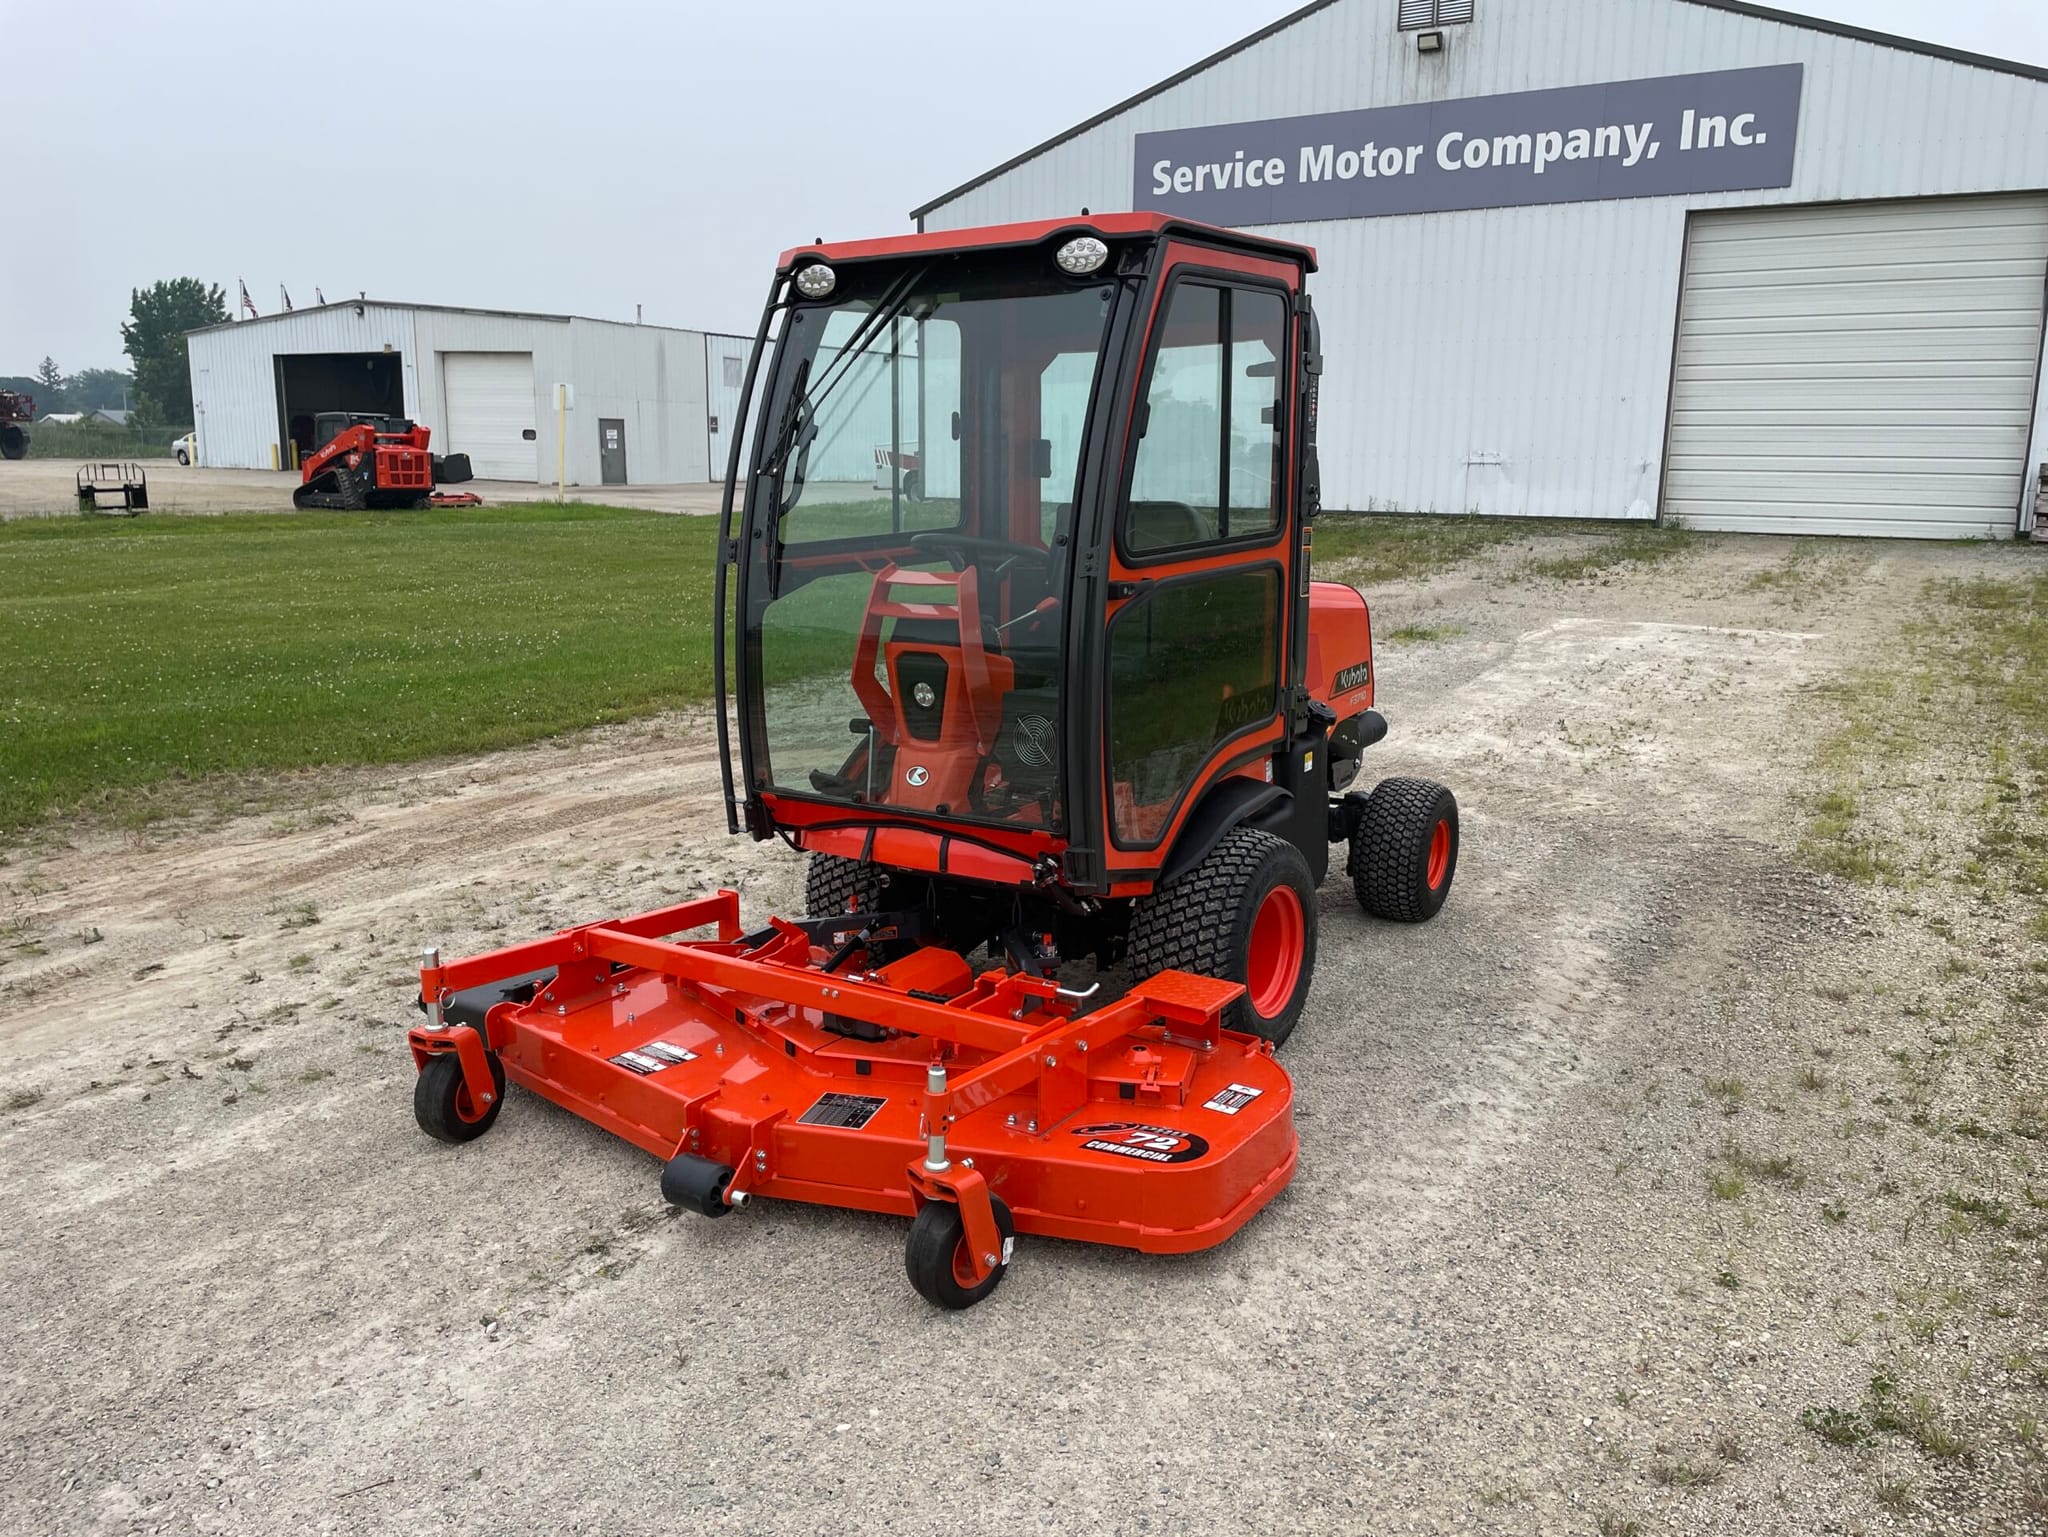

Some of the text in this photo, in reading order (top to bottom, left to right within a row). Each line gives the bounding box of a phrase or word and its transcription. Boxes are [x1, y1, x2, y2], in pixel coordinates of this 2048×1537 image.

[1152, 109, 1768, 196] Service Motor Company, Inc.
[1340, 663, 1368, 689] Kubota
[1085, 1140, 1173, 1162] COMMERCIAL
[1121, 1131, 1180, 1151] 72
